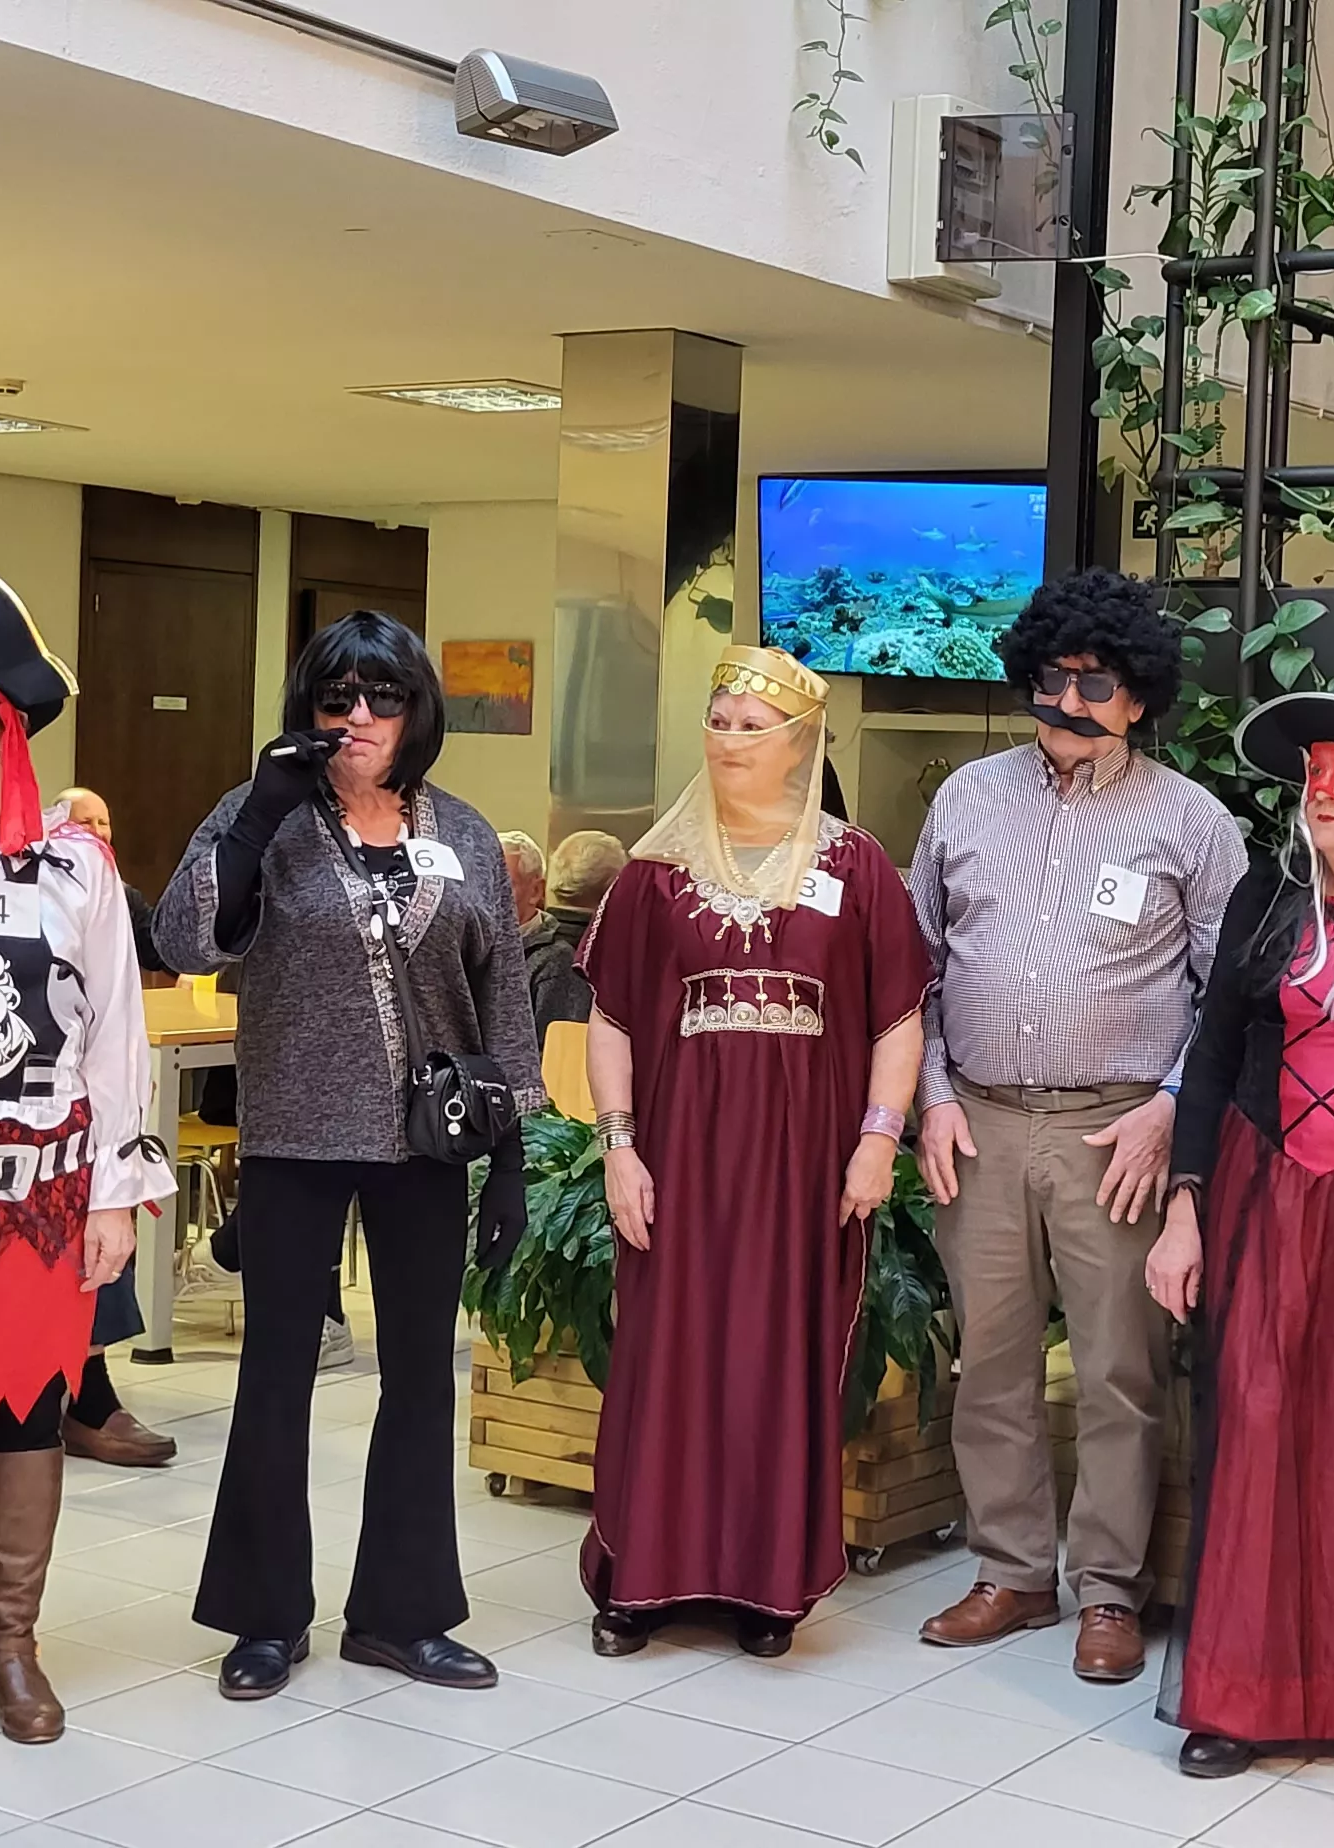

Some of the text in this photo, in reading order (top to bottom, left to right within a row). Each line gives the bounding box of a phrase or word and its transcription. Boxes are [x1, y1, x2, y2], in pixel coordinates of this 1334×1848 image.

[414, 849, 434, 868] 6
[799, 876, 817, 898] 3
[1097, 877, 1118, 905] 8
